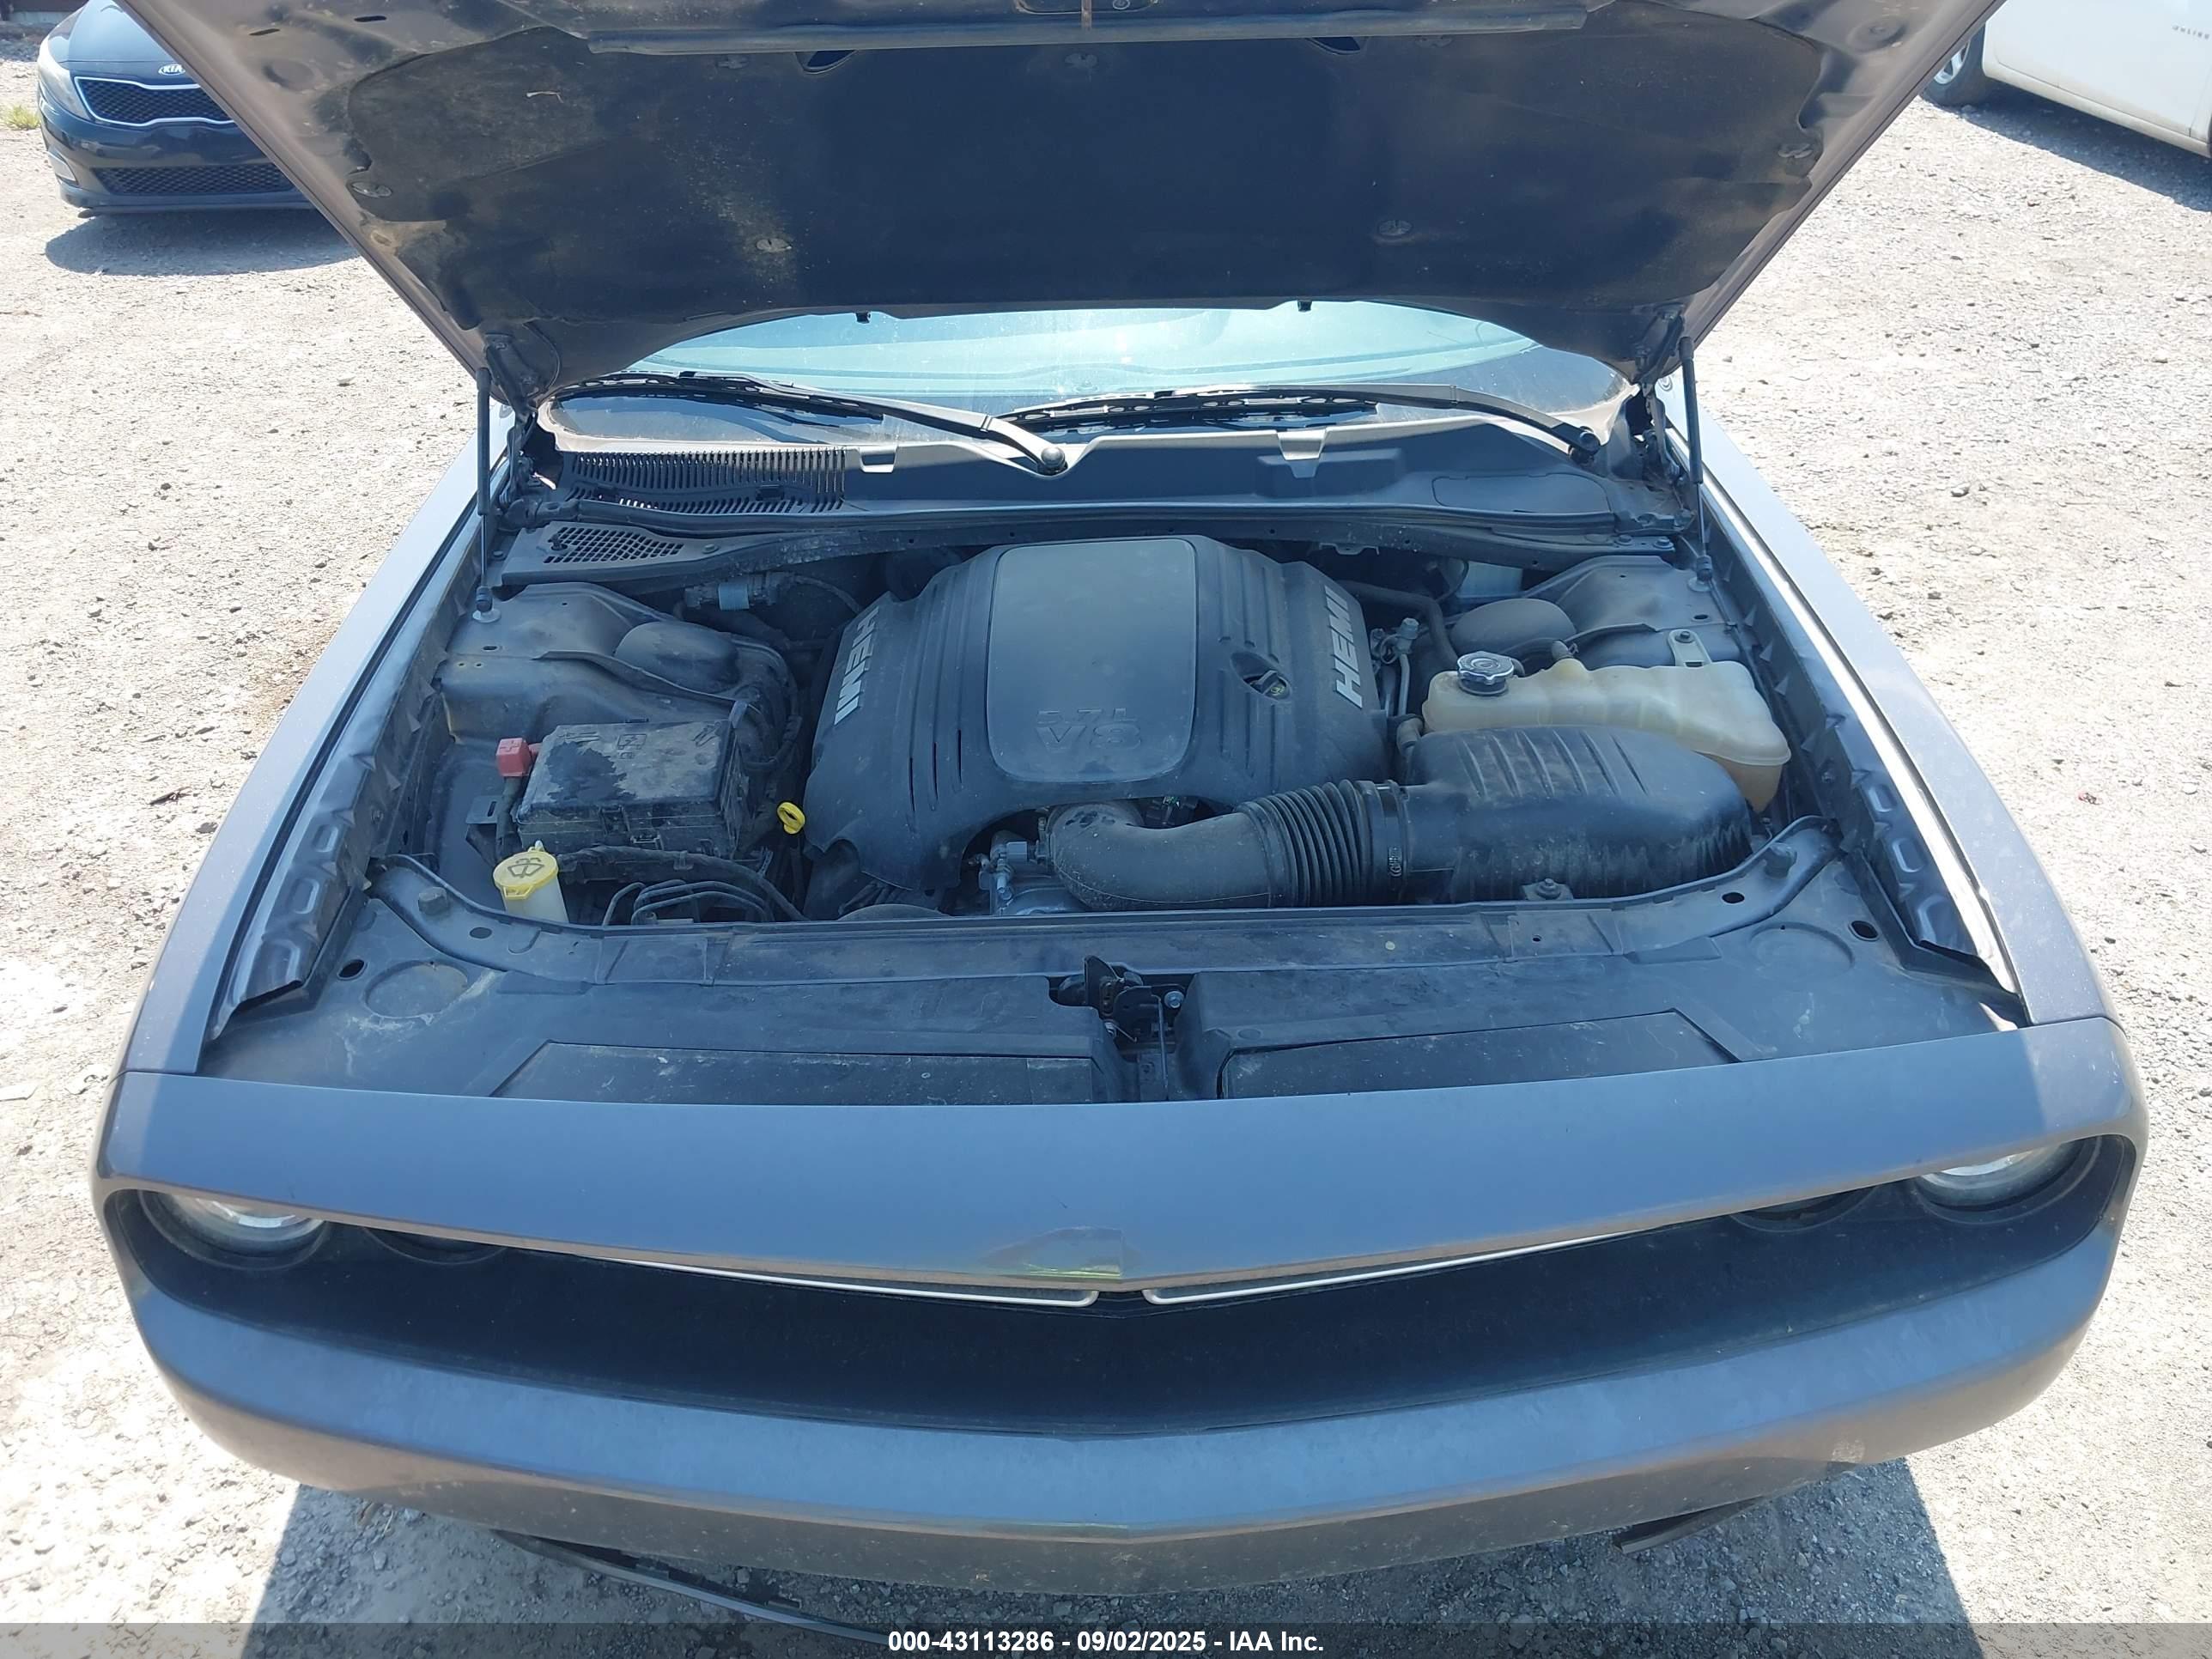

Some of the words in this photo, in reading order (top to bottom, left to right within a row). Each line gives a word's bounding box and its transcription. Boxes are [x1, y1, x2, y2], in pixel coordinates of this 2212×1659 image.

[834, 605, 879, 726] HEMI
[1324, 585, 1363, 708] HEMI
[1035, 724, 1142, 754] V8
